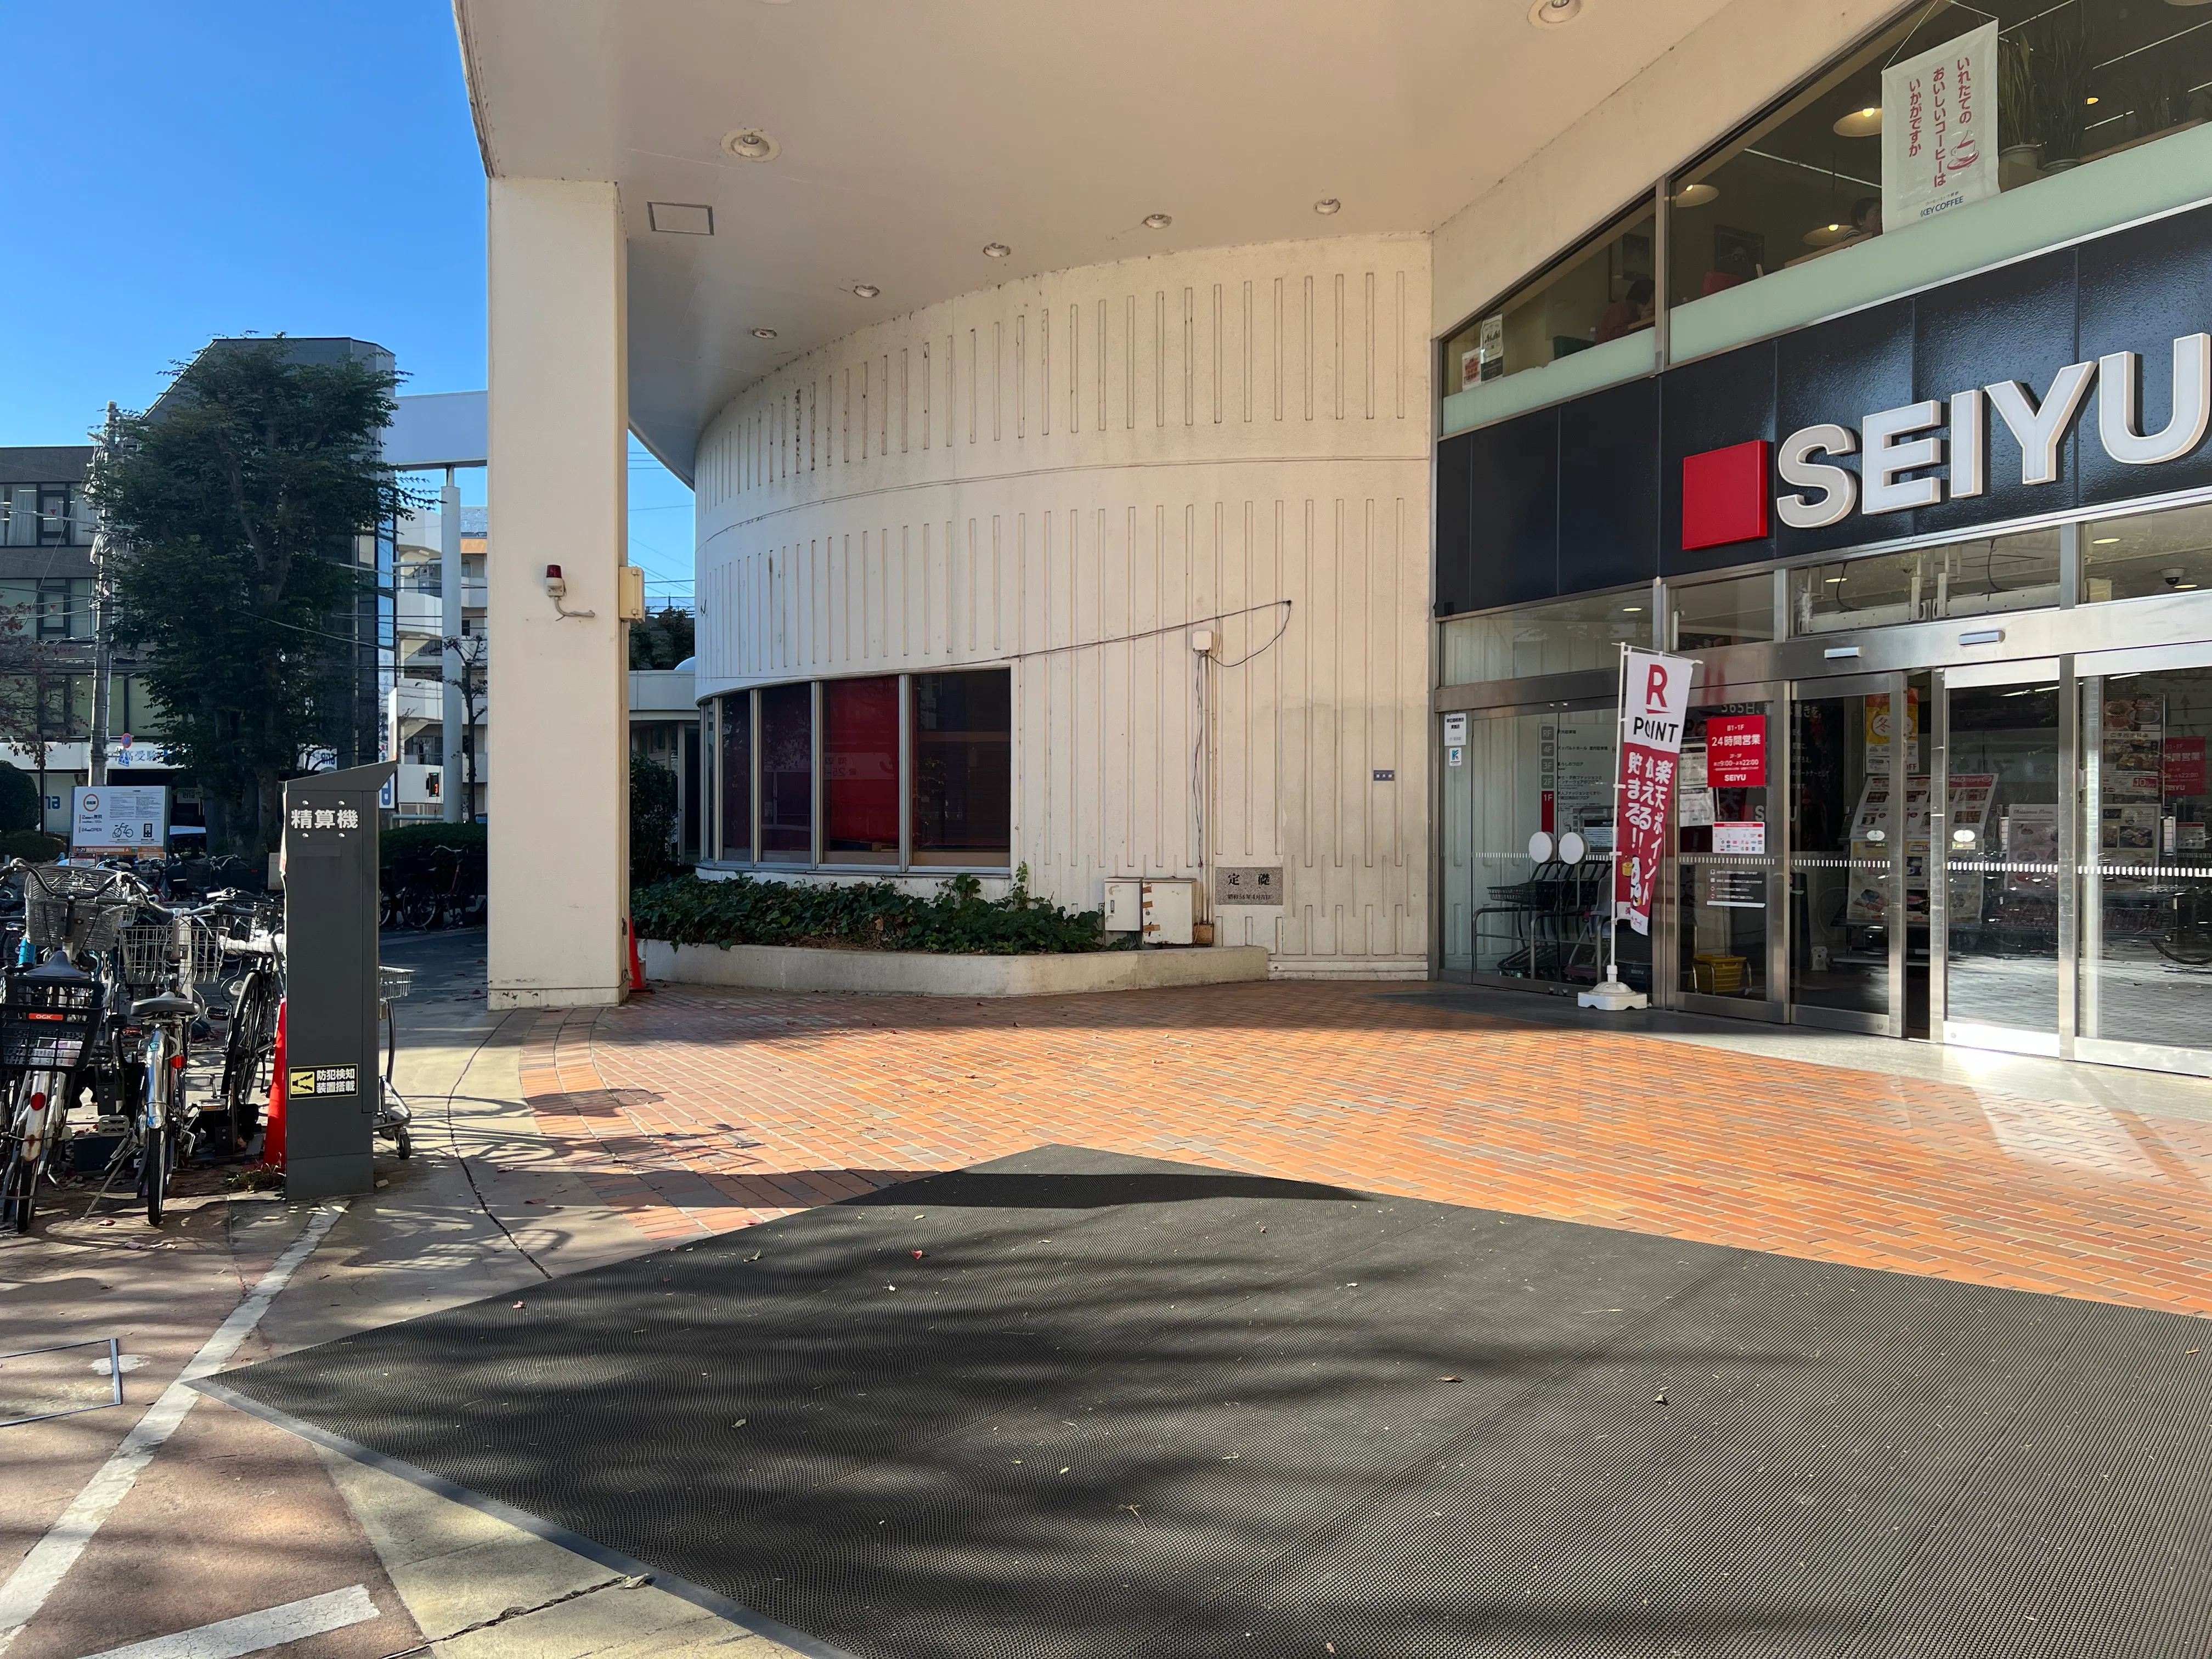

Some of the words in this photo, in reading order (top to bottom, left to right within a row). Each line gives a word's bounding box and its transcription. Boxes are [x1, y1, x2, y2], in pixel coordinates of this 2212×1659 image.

[1957, 57, 1972, 124] いれたての
[1909, 78, 1922, 157] いかがですか
[1933, 66, 1946, 188] おいしいコーヒーは
[1920, 206, 1935, 217] KEY
[1936, 195, 1963, 212] COFFEE
[1776, 332, 2212, 528] SEIYU
[1646, 664, 1668, 708] R
[1711, 733, 1761, 747] 24時間営業
[45, 795, 60, 809] na
[290, 809, 358, 829] 精算機
[1643, 760, 1673, 906] 楽天ポイント
[1227, 873, 1270, 885] 定礎
[317, 1068, 355, 1081] 防犯検知
[317, 1080, 356, 1094] 装置搭載
